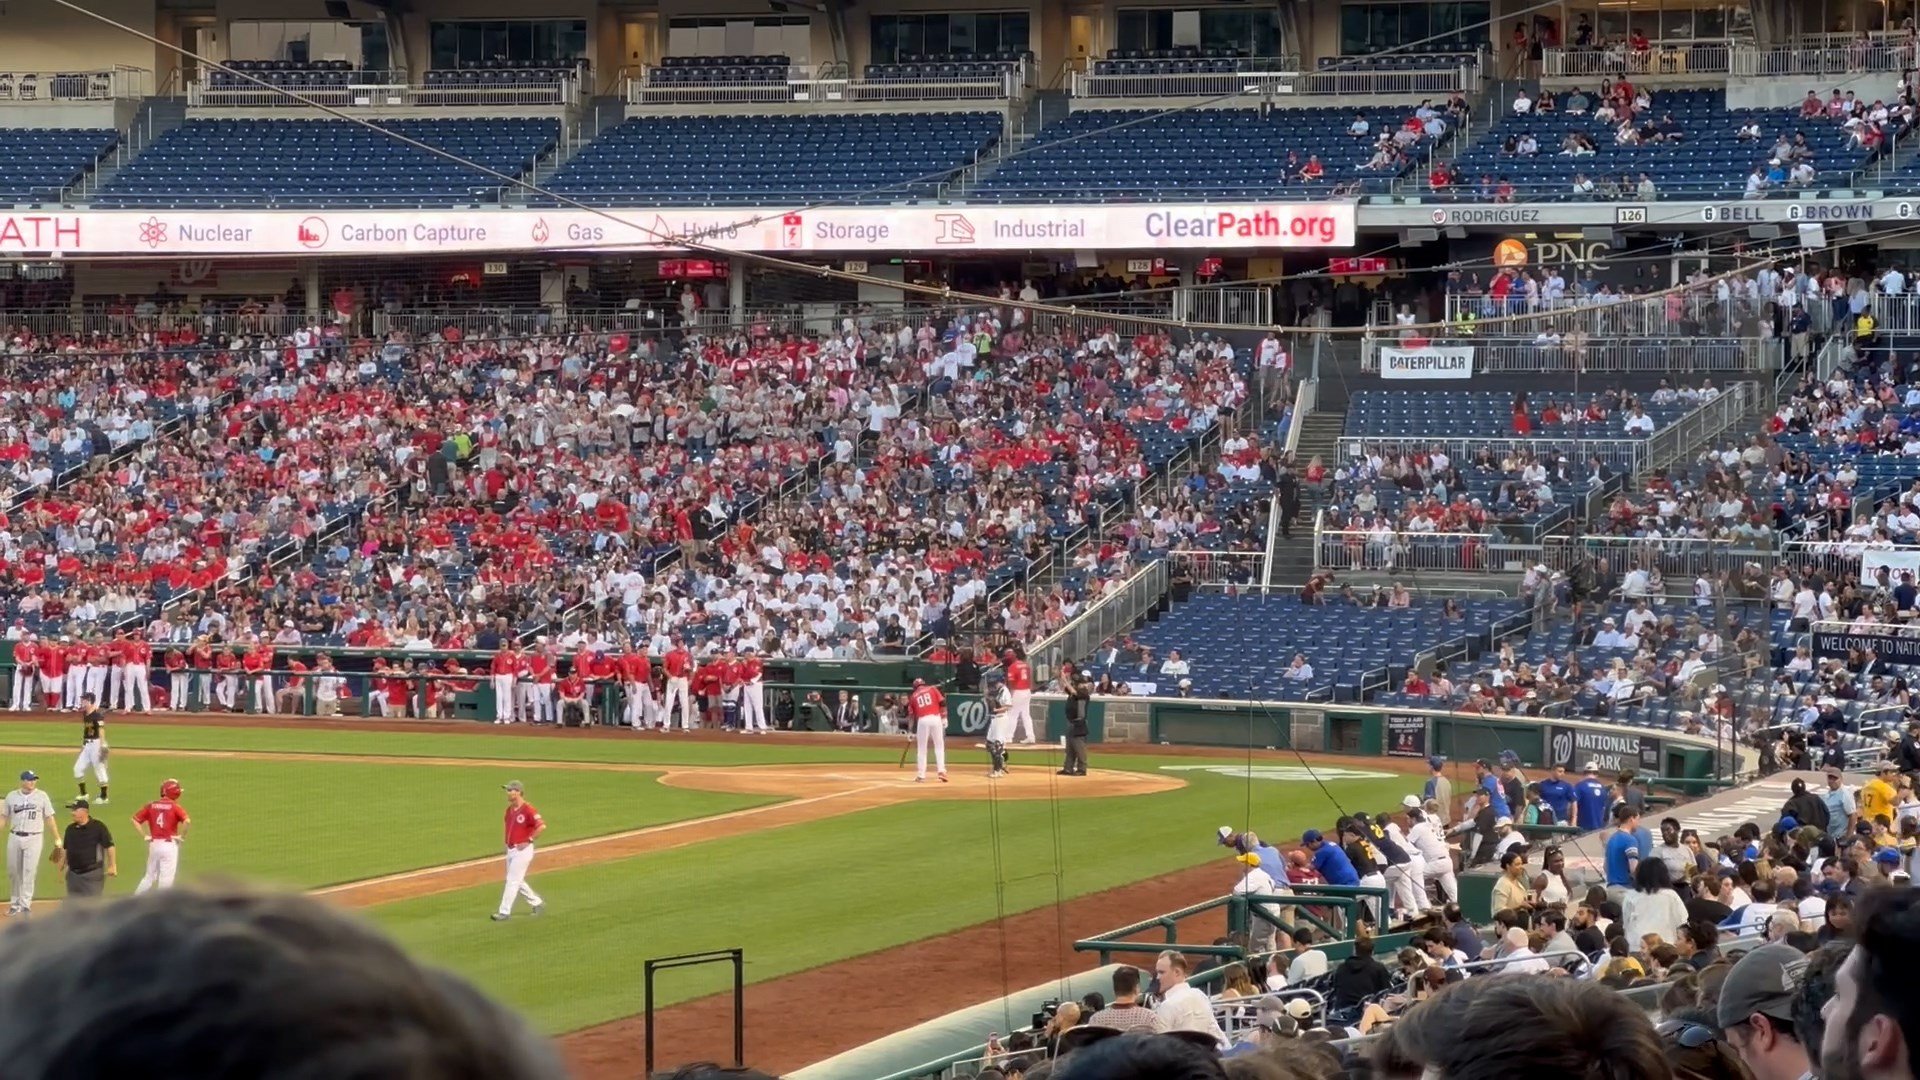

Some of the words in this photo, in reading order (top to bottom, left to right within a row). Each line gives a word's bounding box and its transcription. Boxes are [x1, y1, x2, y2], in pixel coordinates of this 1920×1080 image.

[1452, 209, 1539, 223] RODRIGUEZ
[1621, 210, 1642, 222] 126
[1720, 207, 1765, 221] BELL
[1806, 205, 1873, 219] BROWN
[179, 224, 252, 242] Nuclear
[341, 224, 407, 242] Carbon
[413, 223, 487, 245] Capture
[567, 223, 604, 241] Gas
[684, 221, 738, 245] Hydro
[816, 222, 890, 243] Storage
[994, 218, 1085, 239] Industrial
[1145, 210, 1336, 243] ClearPath.org
[1534, 242, 1611, 270] PNC
[1390, 356, 1466, 370] CATERPILLAR
[1821, 636, 1878, 652] WELCOME
[1881, 639, 1894, 654] TO
[1575, 733, 1640, 755] NATIONALS
[1593, 753, 1621, 771] PARK
[28, 811, 37, 820] 10
[156, 813, 165, 829] 4
